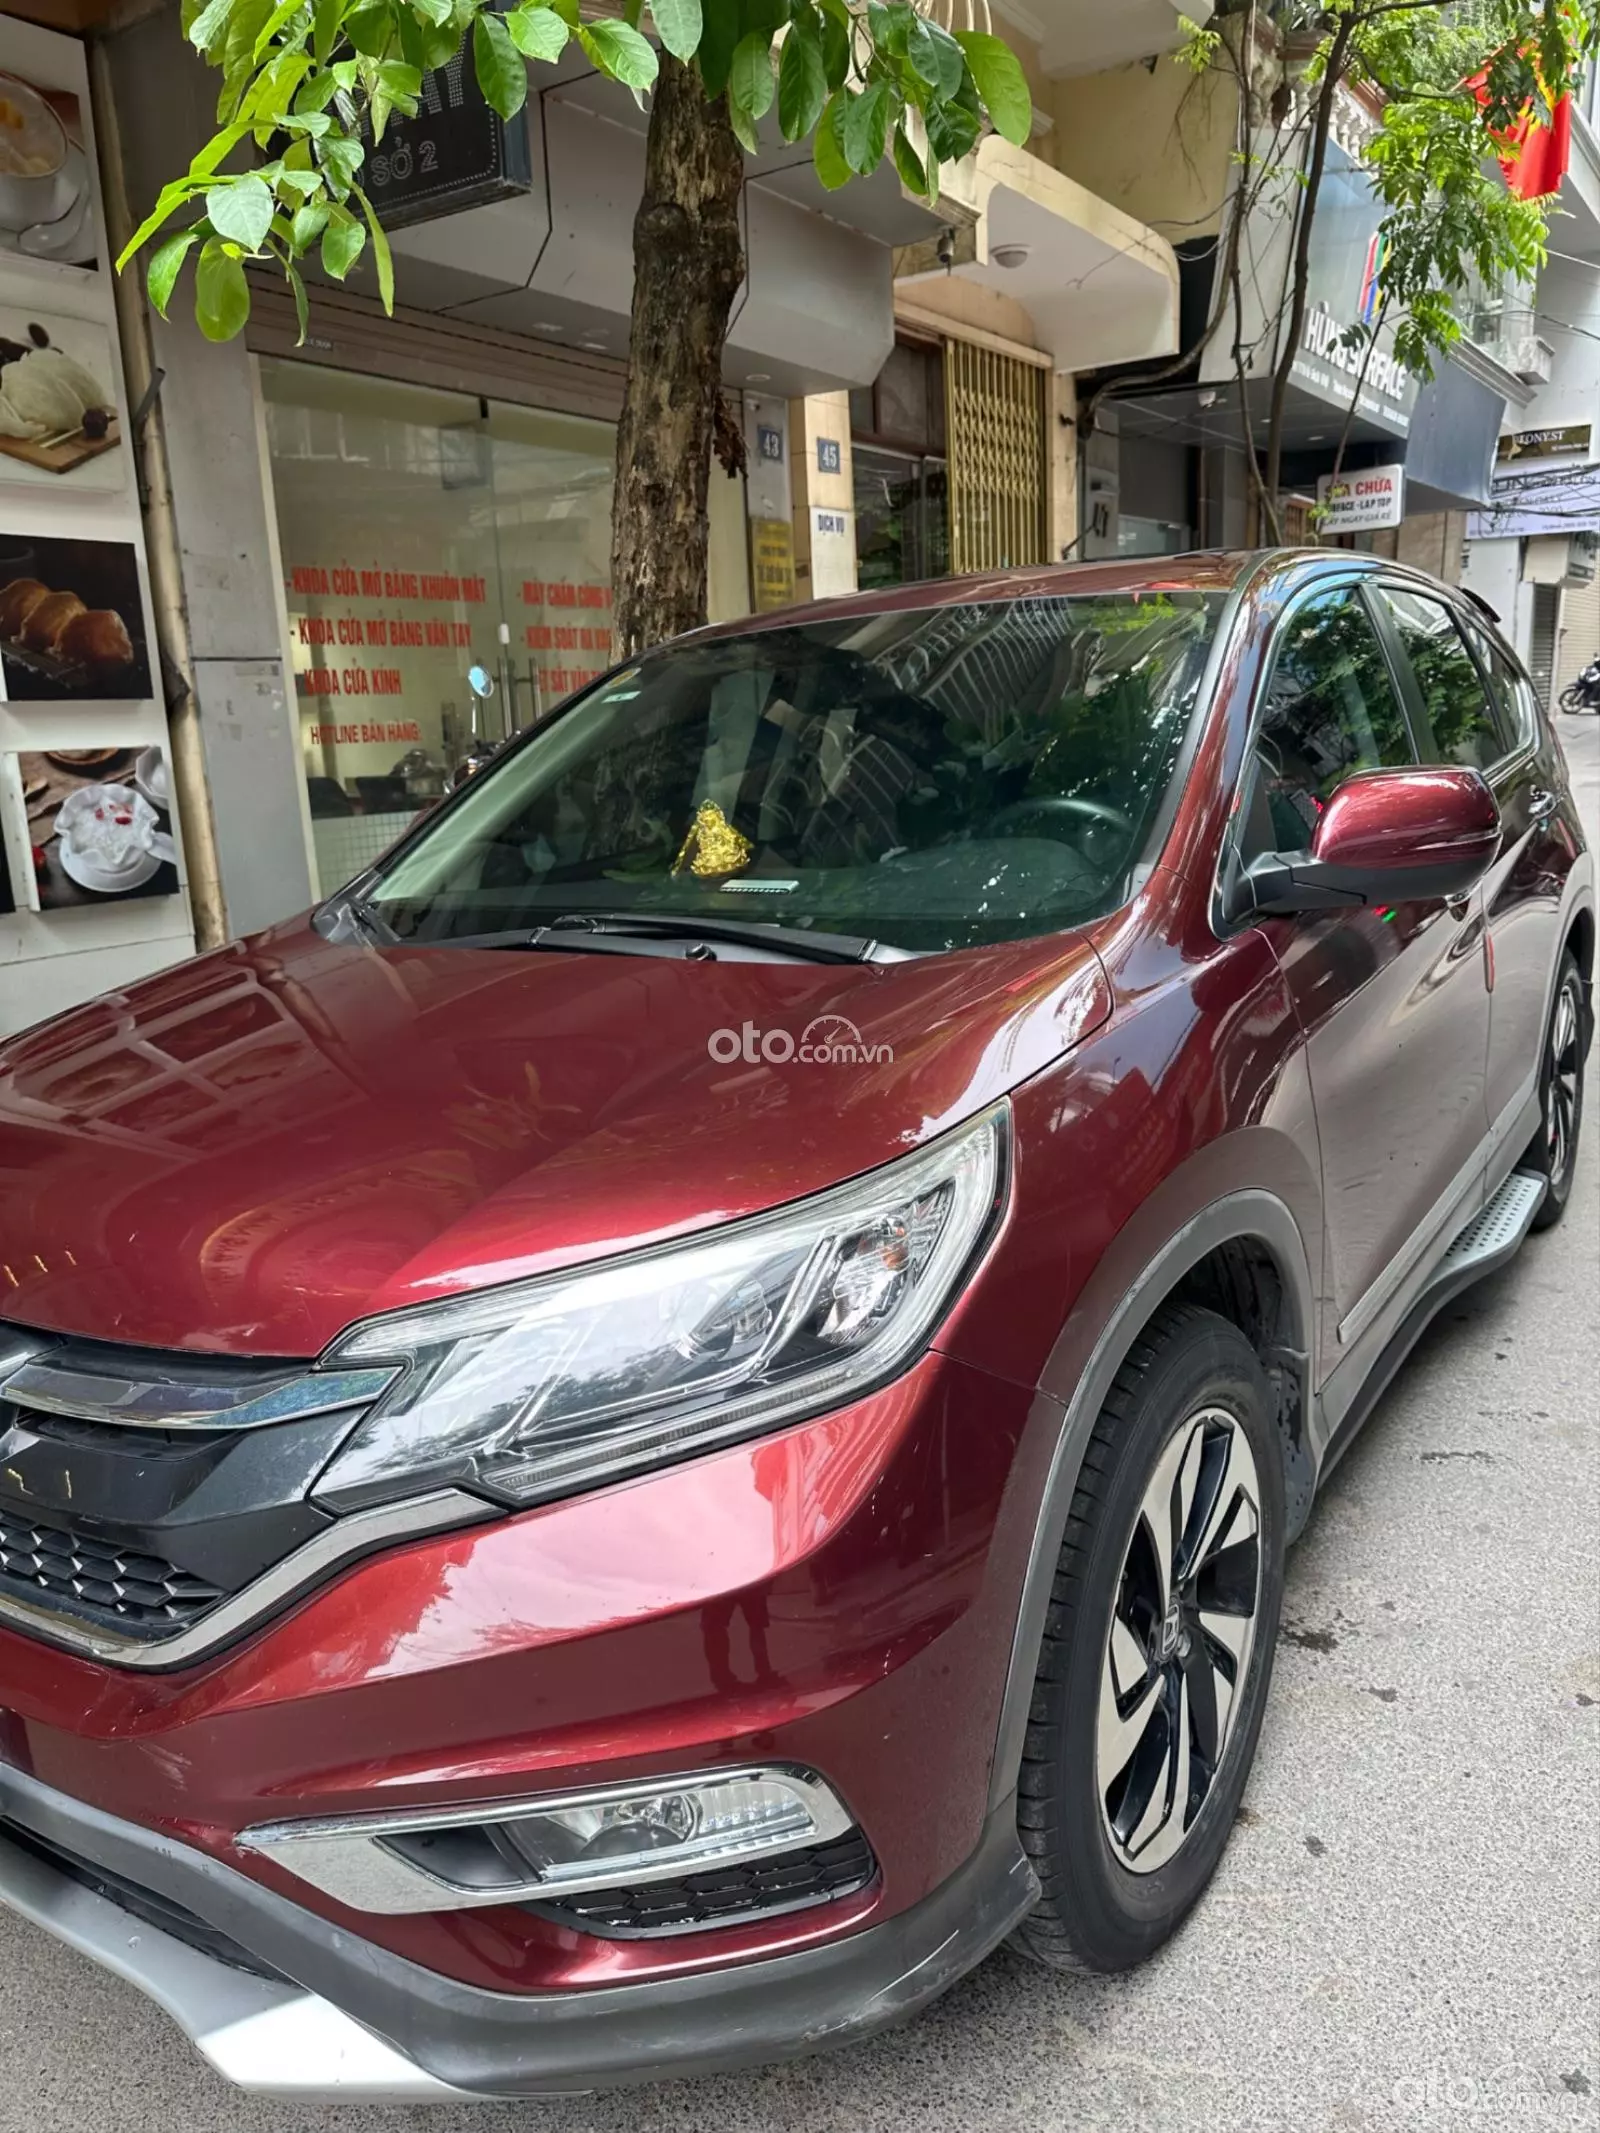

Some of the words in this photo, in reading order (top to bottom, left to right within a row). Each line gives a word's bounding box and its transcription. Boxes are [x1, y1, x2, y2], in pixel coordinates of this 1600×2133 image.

[419, 140, 438, 173] 2
[763, 432, 779, 458] 43
[822, 443, 837, 468] 45
[1356, 477, 1392, 496] CHỮA
[332, 559, 359, 597] CỬA
[361, 560, 382, 598] MỞ
[338, 608, 364, 647] CỬA
[366, 609, 387, 647] MỞ
[452, 623, 471, 648] TAY
[343, 657, 370, 696] CỬA
[372, 664, 403, 696] KÍNH
[310, 725, 359, 745] HOTLINE
